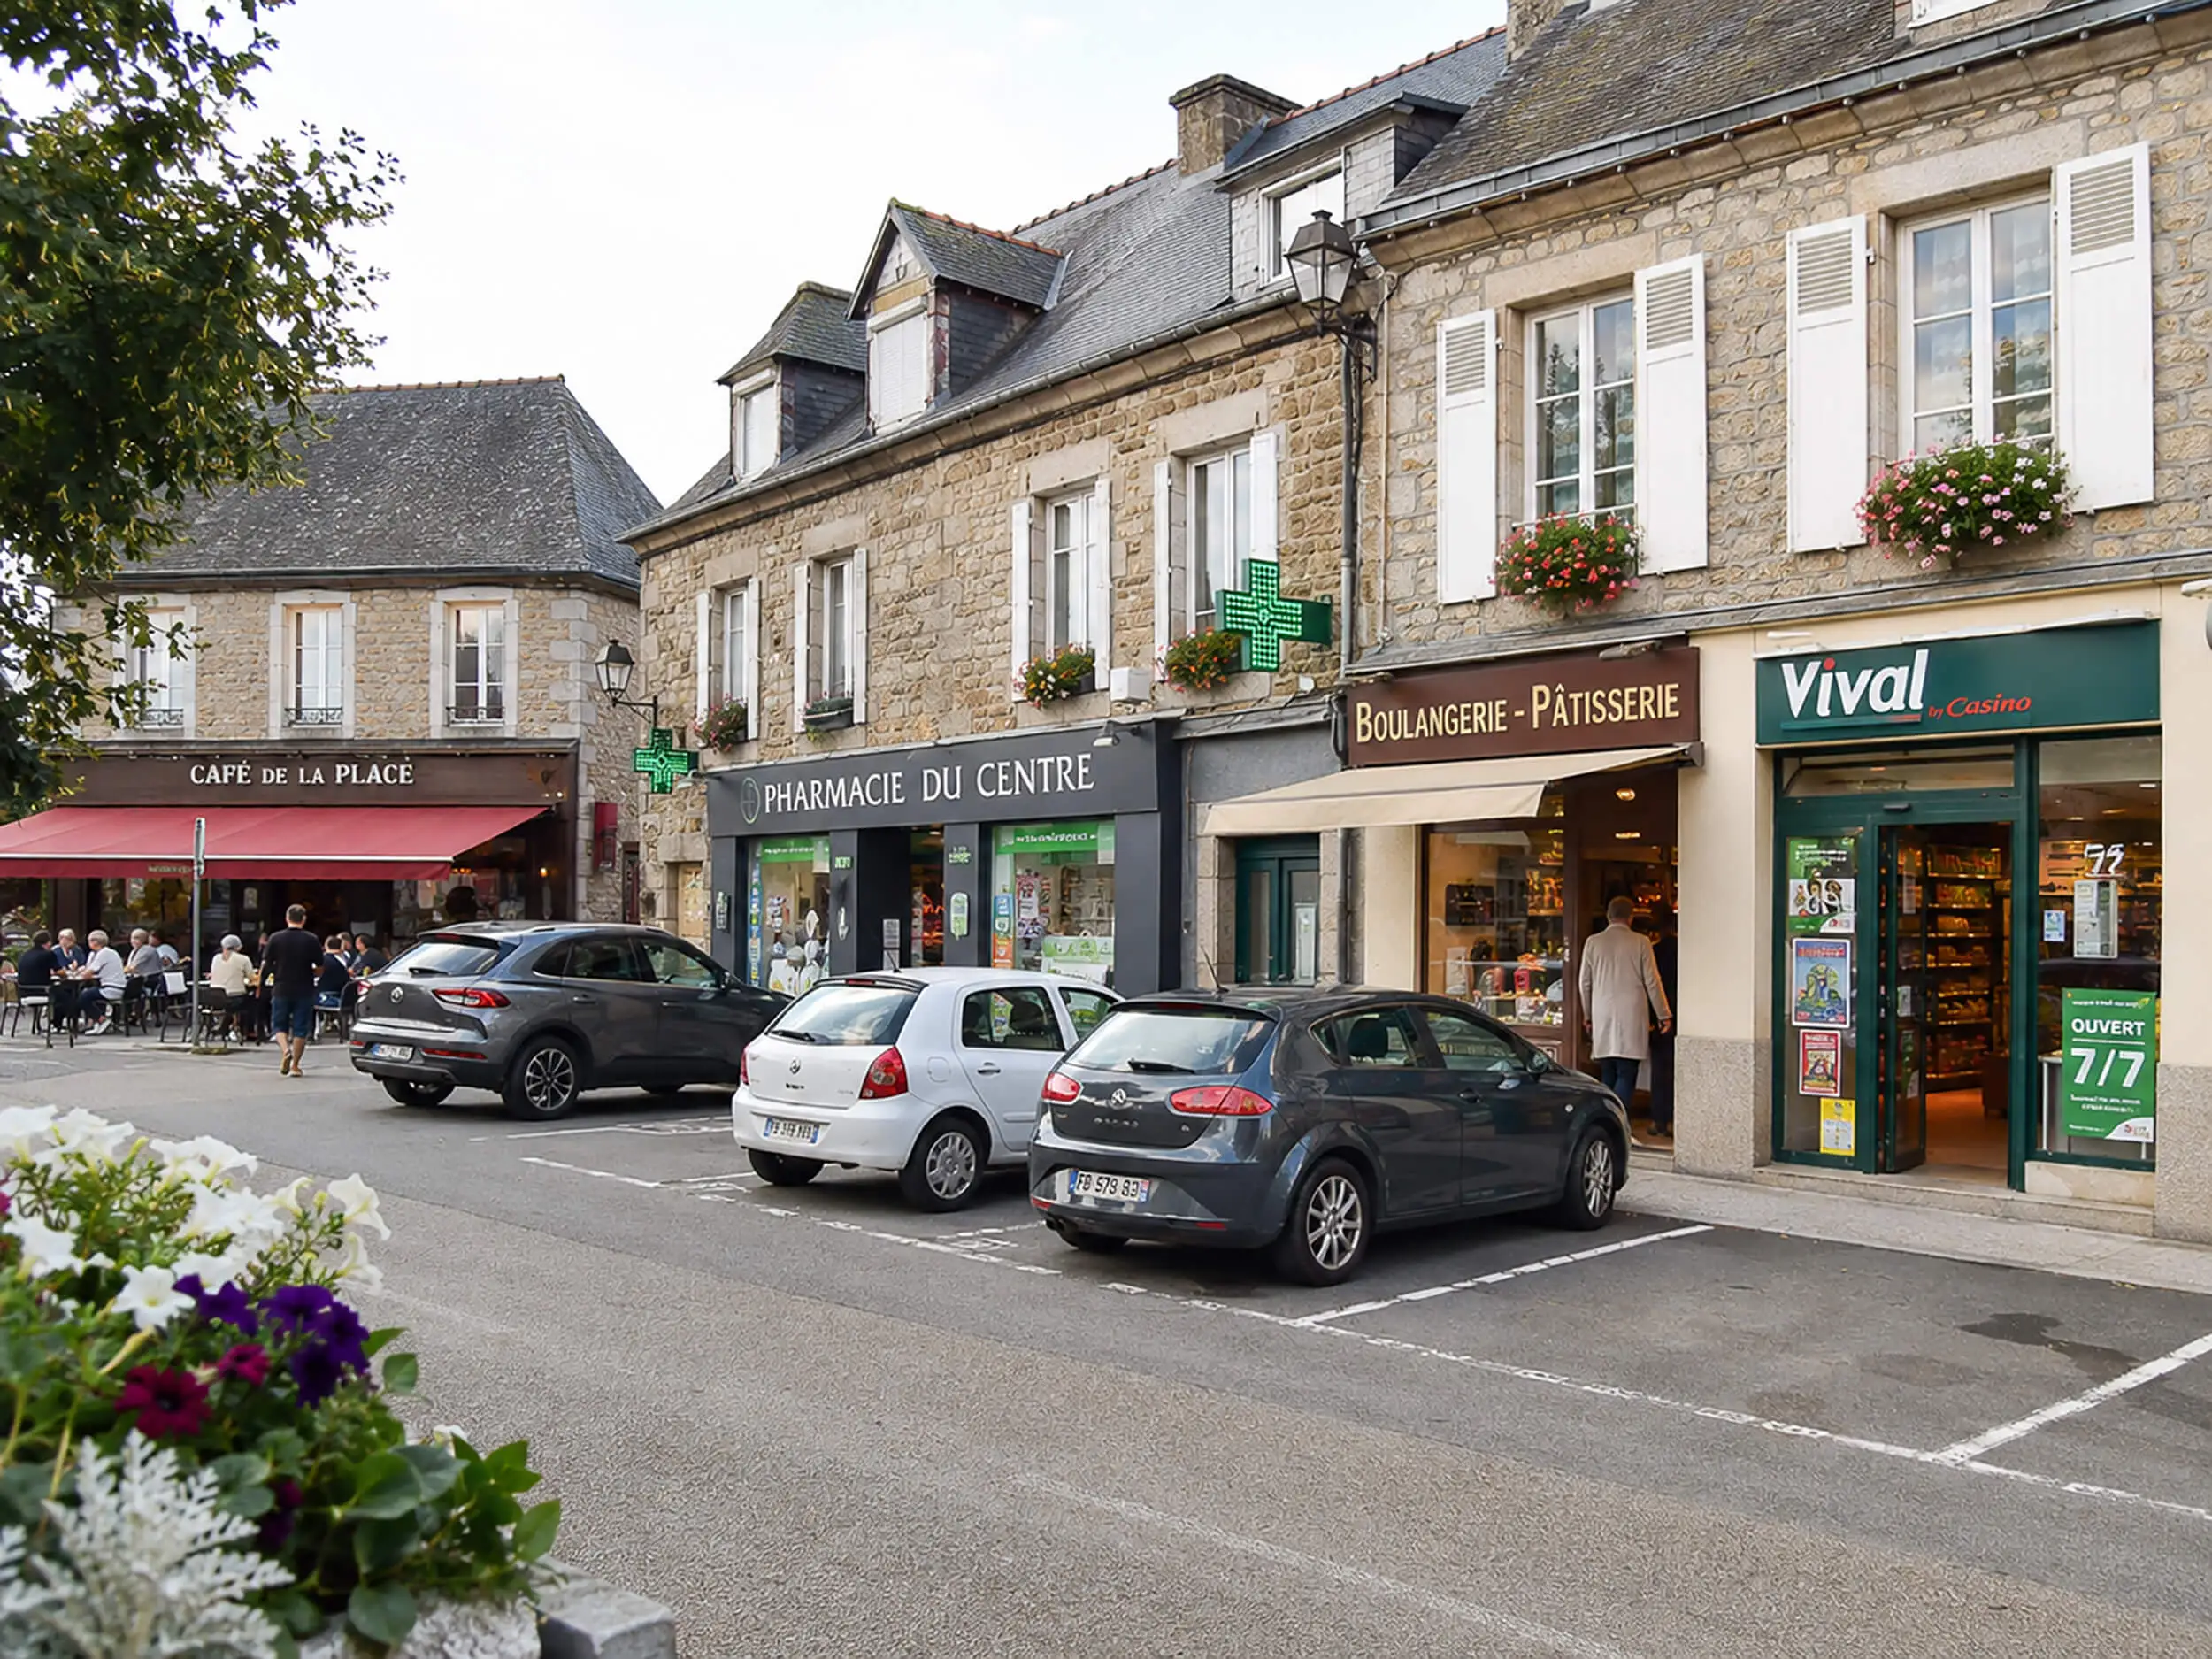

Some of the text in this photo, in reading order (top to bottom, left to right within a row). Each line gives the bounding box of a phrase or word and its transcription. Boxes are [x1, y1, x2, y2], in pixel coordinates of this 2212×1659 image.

[1781, 649, 1929, 718] Vival
[1356, 699, 1508, 742] BOULANGERIE
[1532, 683, 1680, 729] PÂTISSERIE
[1946, 693, 2032, 718] Casino
[189, 759, 252, 785] CAFÉ
[261, 768, 288, 785] DE
[298, 767, 326, 785] LA
[764, 753, 1095, 814] PHARMACIE DU CENTRE
[2071, 1018, 2146, 1037] OUVERT
[2070, 1047, 2146, 1088] 7/7
